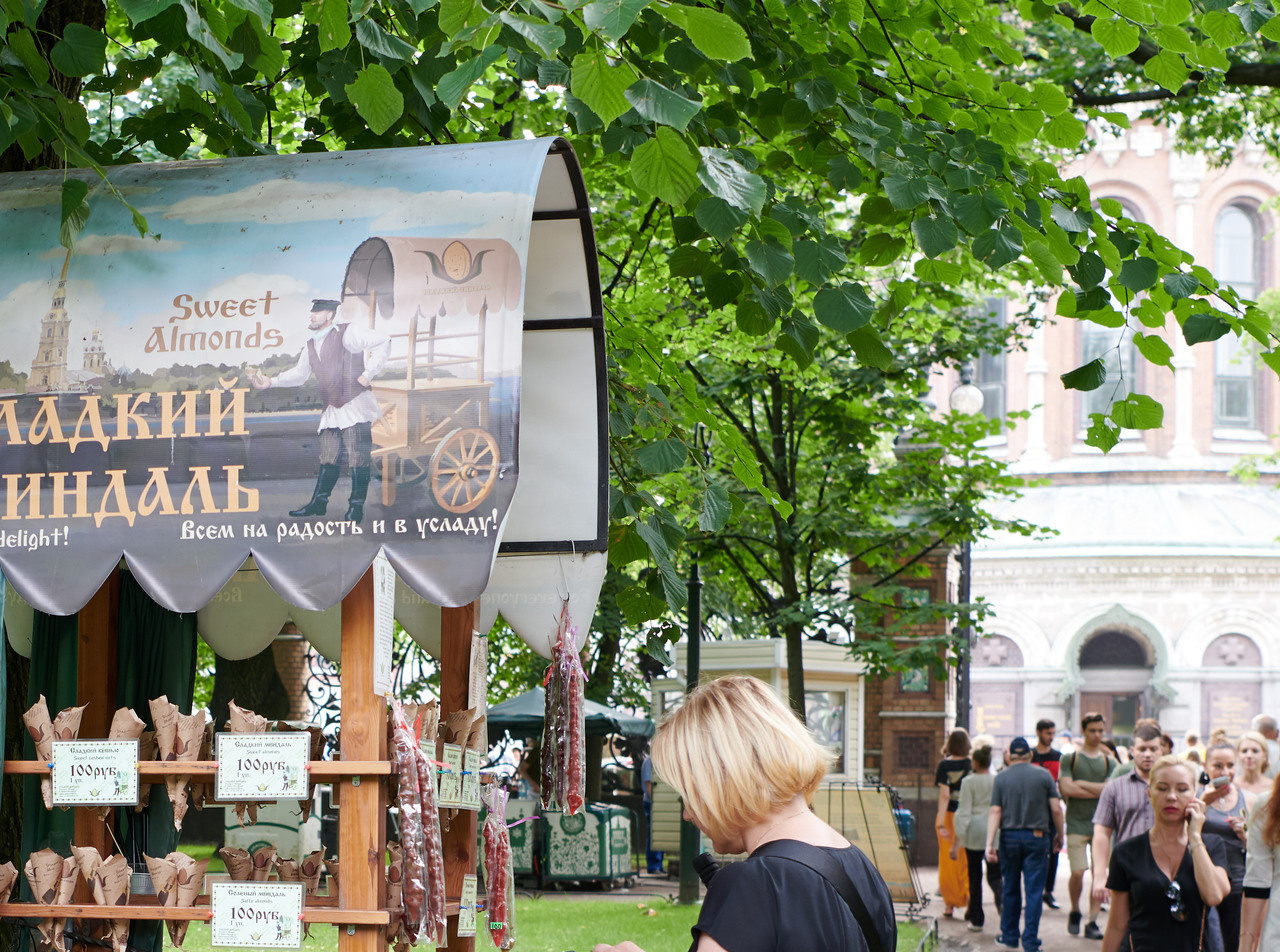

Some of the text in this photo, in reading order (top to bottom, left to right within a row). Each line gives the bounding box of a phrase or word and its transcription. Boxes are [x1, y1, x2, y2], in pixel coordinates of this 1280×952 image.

[169, 290, 279, 323] Sweet
[144, 322, 284, 353] Almonds
[180, 508, 497, 542] Всем на радость и в усладу!
